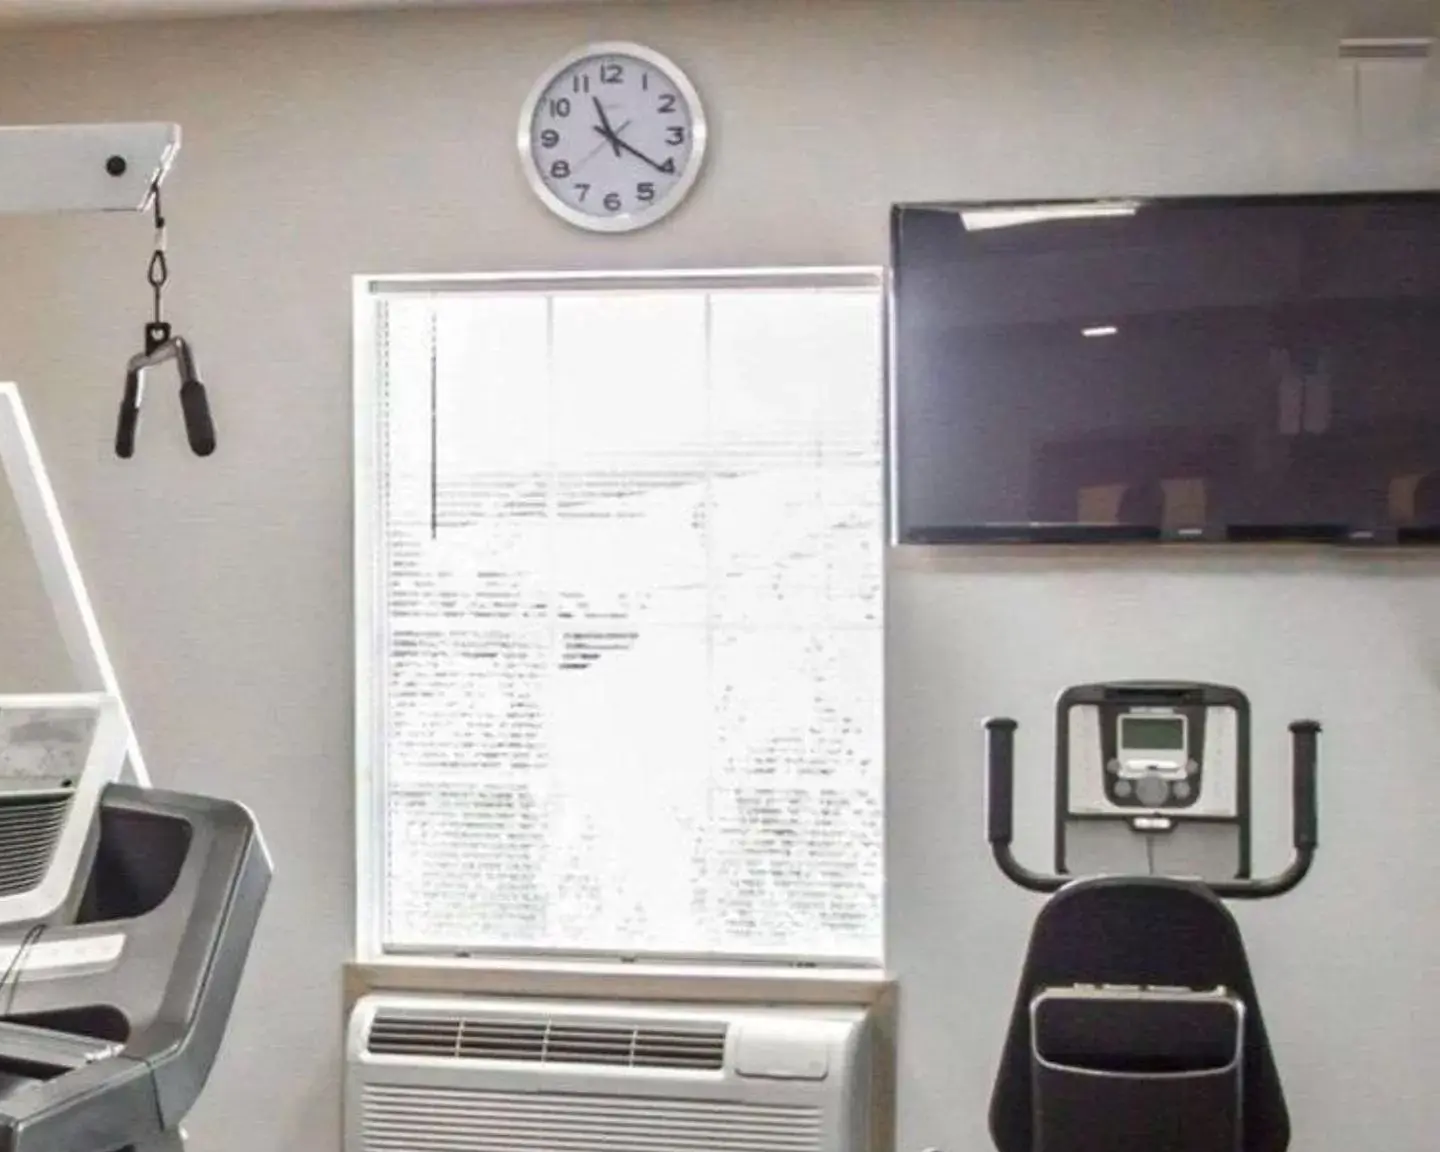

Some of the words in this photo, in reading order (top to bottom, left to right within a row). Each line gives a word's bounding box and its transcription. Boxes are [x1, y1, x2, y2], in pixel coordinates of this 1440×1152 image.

[573, 74, 590, 93] 11
[600, 64, 624, 84] 12
[642, 73, 648, 91] 1
[549, 97, 571, 117] 10
[657, 93, 676, 114] 2
[540, 129, 559, 149] 9
[665, 126, 685, 146] 3
[550, 160, 571, 178] 8
[574, 183, 590, 202] 7
[636, 182, 655, 201] 5
[603, 192, 622, 211] 6
